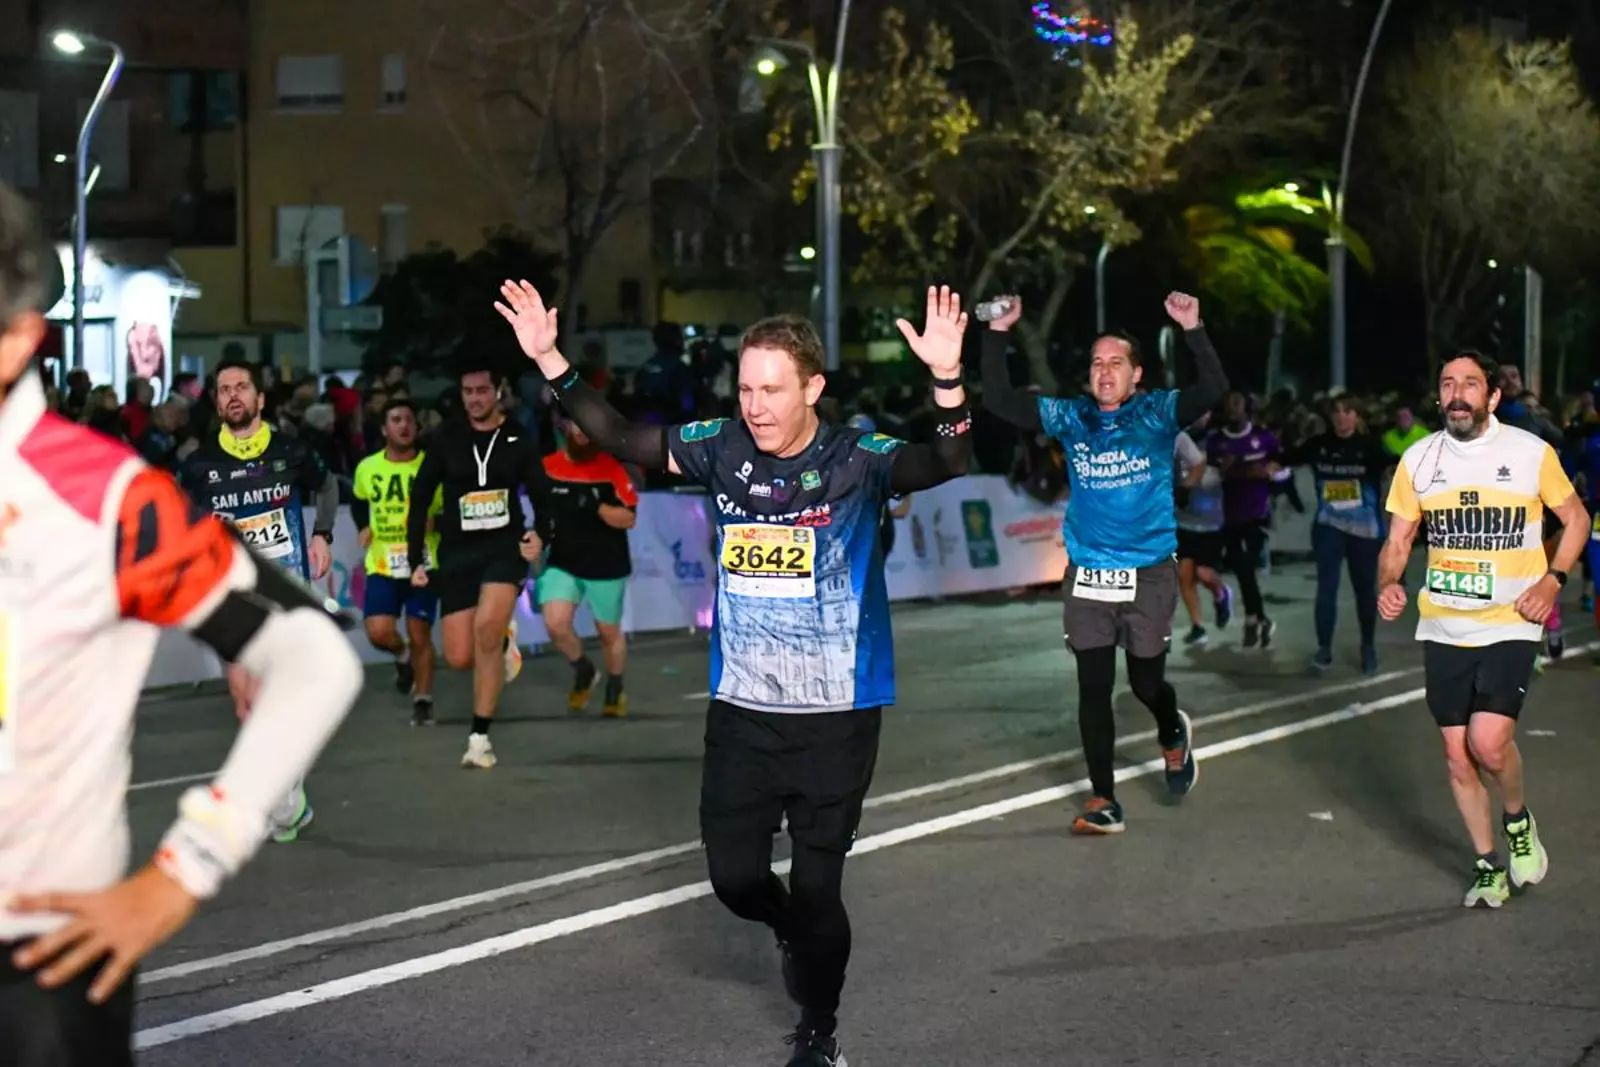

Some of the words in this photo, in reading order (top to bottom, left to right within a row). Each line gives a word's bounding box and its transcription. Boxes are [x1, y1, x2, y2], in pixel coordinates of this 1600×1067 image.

[1090, 450, 1128, 464] MEDIA
[1090, 456, 1150, 478] MARATÓN
[212, 493, 239, 510] SAN
[243, 482, 290, 506] ANTÓN
[1459, 491, 1479, 506] 59
[728, 545, 805, 569] 3642
[1083, 567, 1130, 585] 9139
[1431, 571, 1489, 594] 2148
